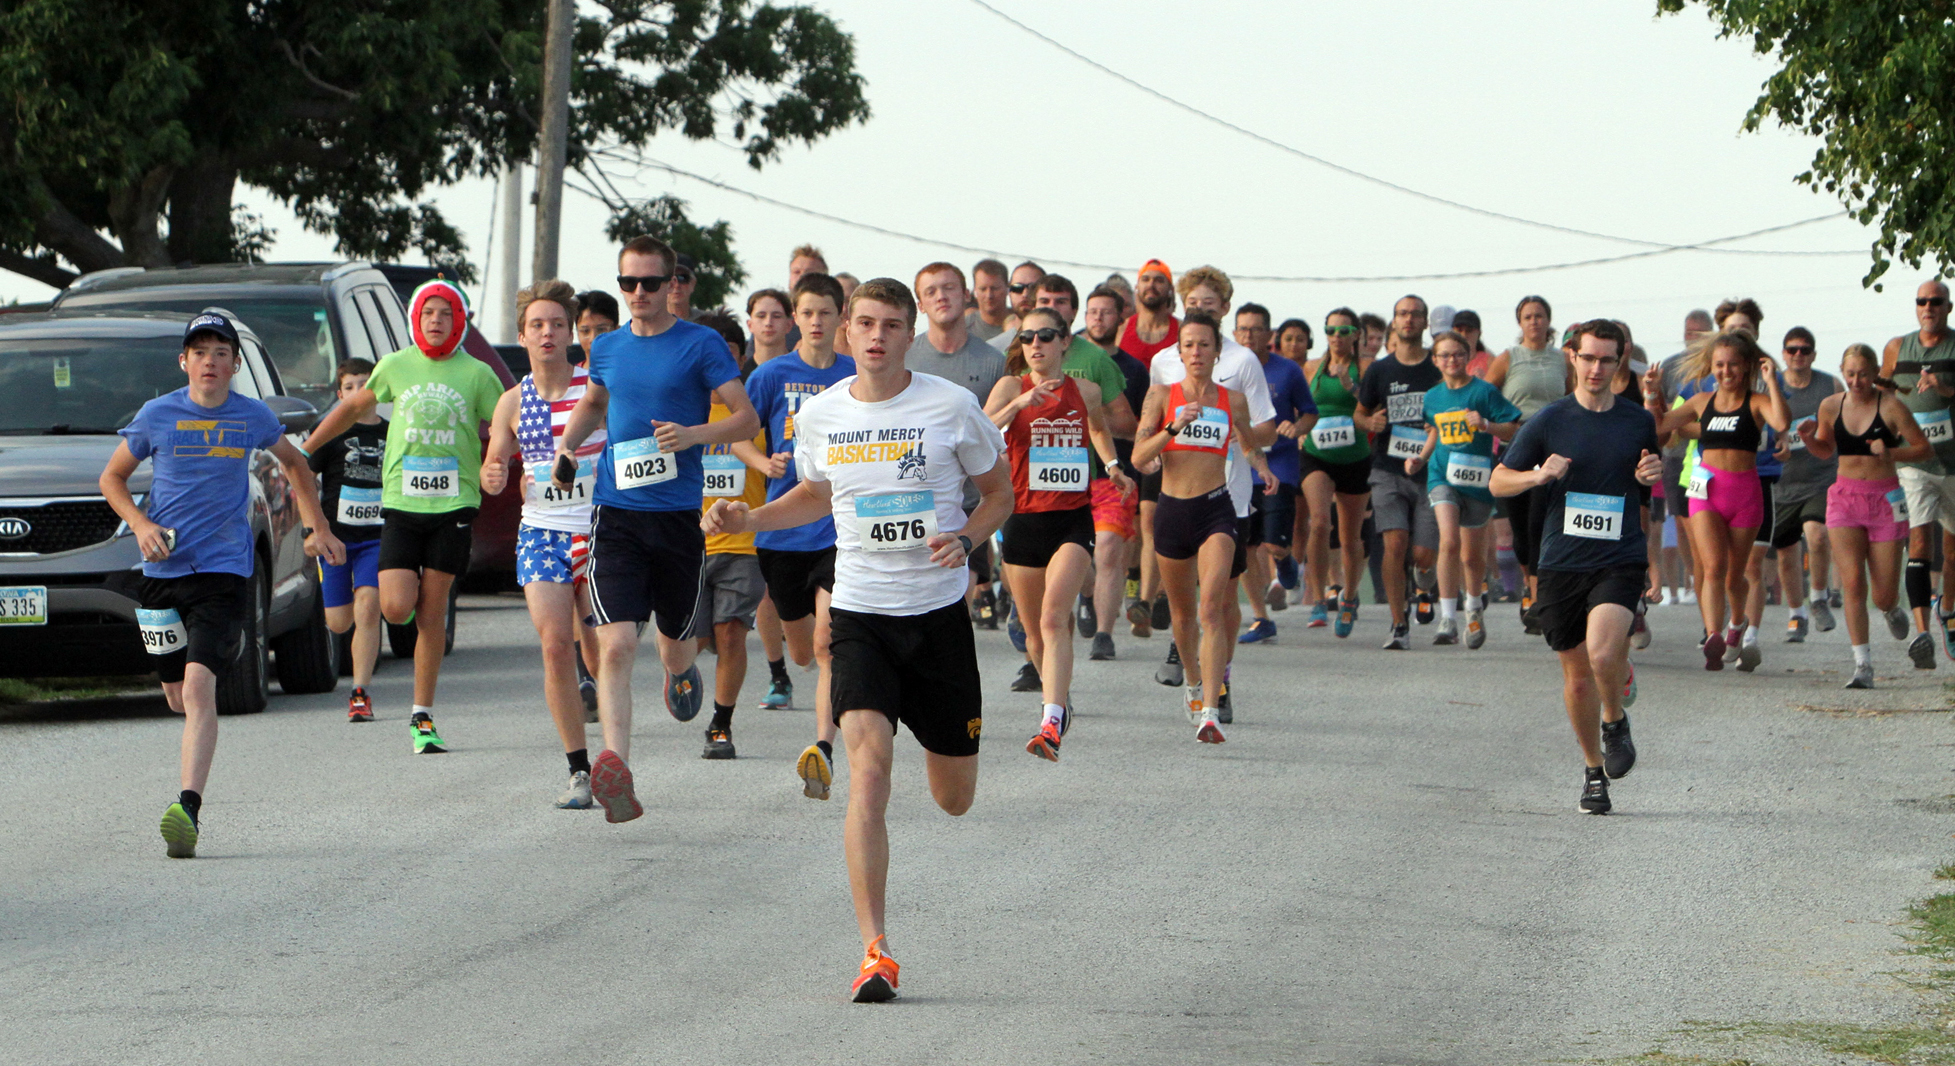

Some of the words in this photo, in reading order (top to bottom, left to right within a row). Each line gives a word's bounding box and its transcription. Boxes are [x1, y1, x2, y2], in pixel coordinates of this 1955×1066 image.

[1183, 424, 1221, 440] 4694
[1441, 420, 1470, 437] FFA
[1706, 416, 1740, 431] NIKE
[223, 432, 254, 448] FIELD
[404, 427, 456, 445] GYM
[828, 430, 872, 445] MOUNT
[878, 427, 925, 441] MERCY
[1318, 430, 1348, 443] 4174
[827, 442, 927, 466] BASKETBALL
[624, 457, 667, 479] 4023
[1038, 467, 1080, 484] 4600
[1453, 468, 1483, 482] 4651
[411, 476, 449, 491] 4648
[702, 474, 735, 489] 981
[345, 505, 380, 519] 4669
[870, 519, 926, 542] 4676
[1572, 513, 1613, 532] 4691
[12, 599, 36, 617] 335
[141, 629, 178, 646] 3976
